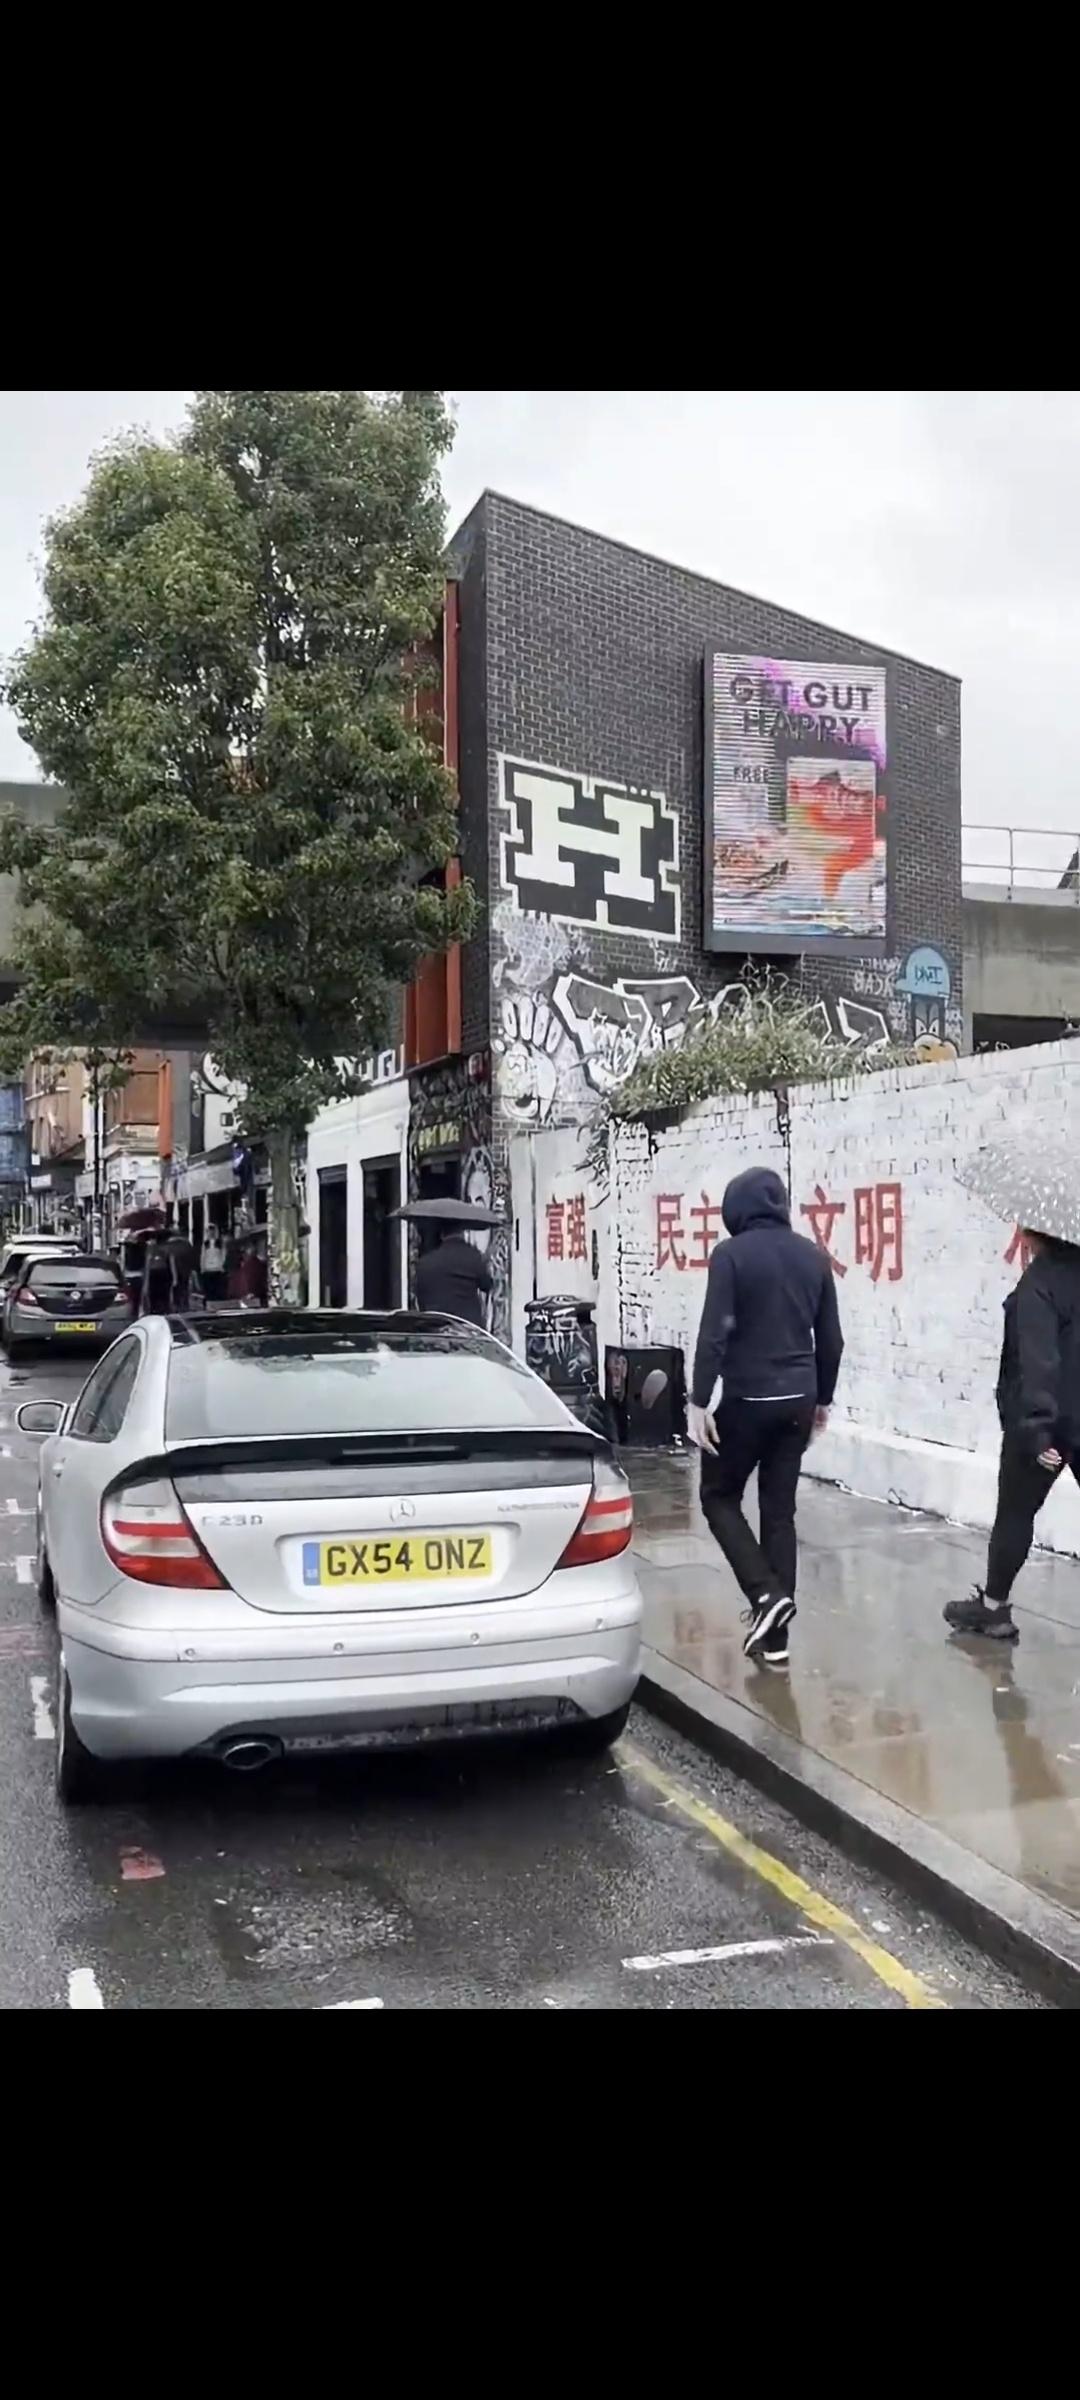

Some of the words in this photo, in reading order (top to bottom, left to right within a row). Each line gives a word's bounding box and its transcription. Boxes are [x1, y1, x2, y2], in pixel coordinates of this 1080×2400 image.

[729, 676, 793, 707] GET
[803, 682, 874, 712] GUT
[742, 708, 861, 745] HAPPY
[513, 771, 655, 903] H
[545, 1193, 588, 1261] 富强
[654, 1190, 722, 1272] 民主
[799, 1182, 903, 1283] 文明
[326, 1541, 413, 1578] GX54
[424, 1538, 487, 1571] ONZ
